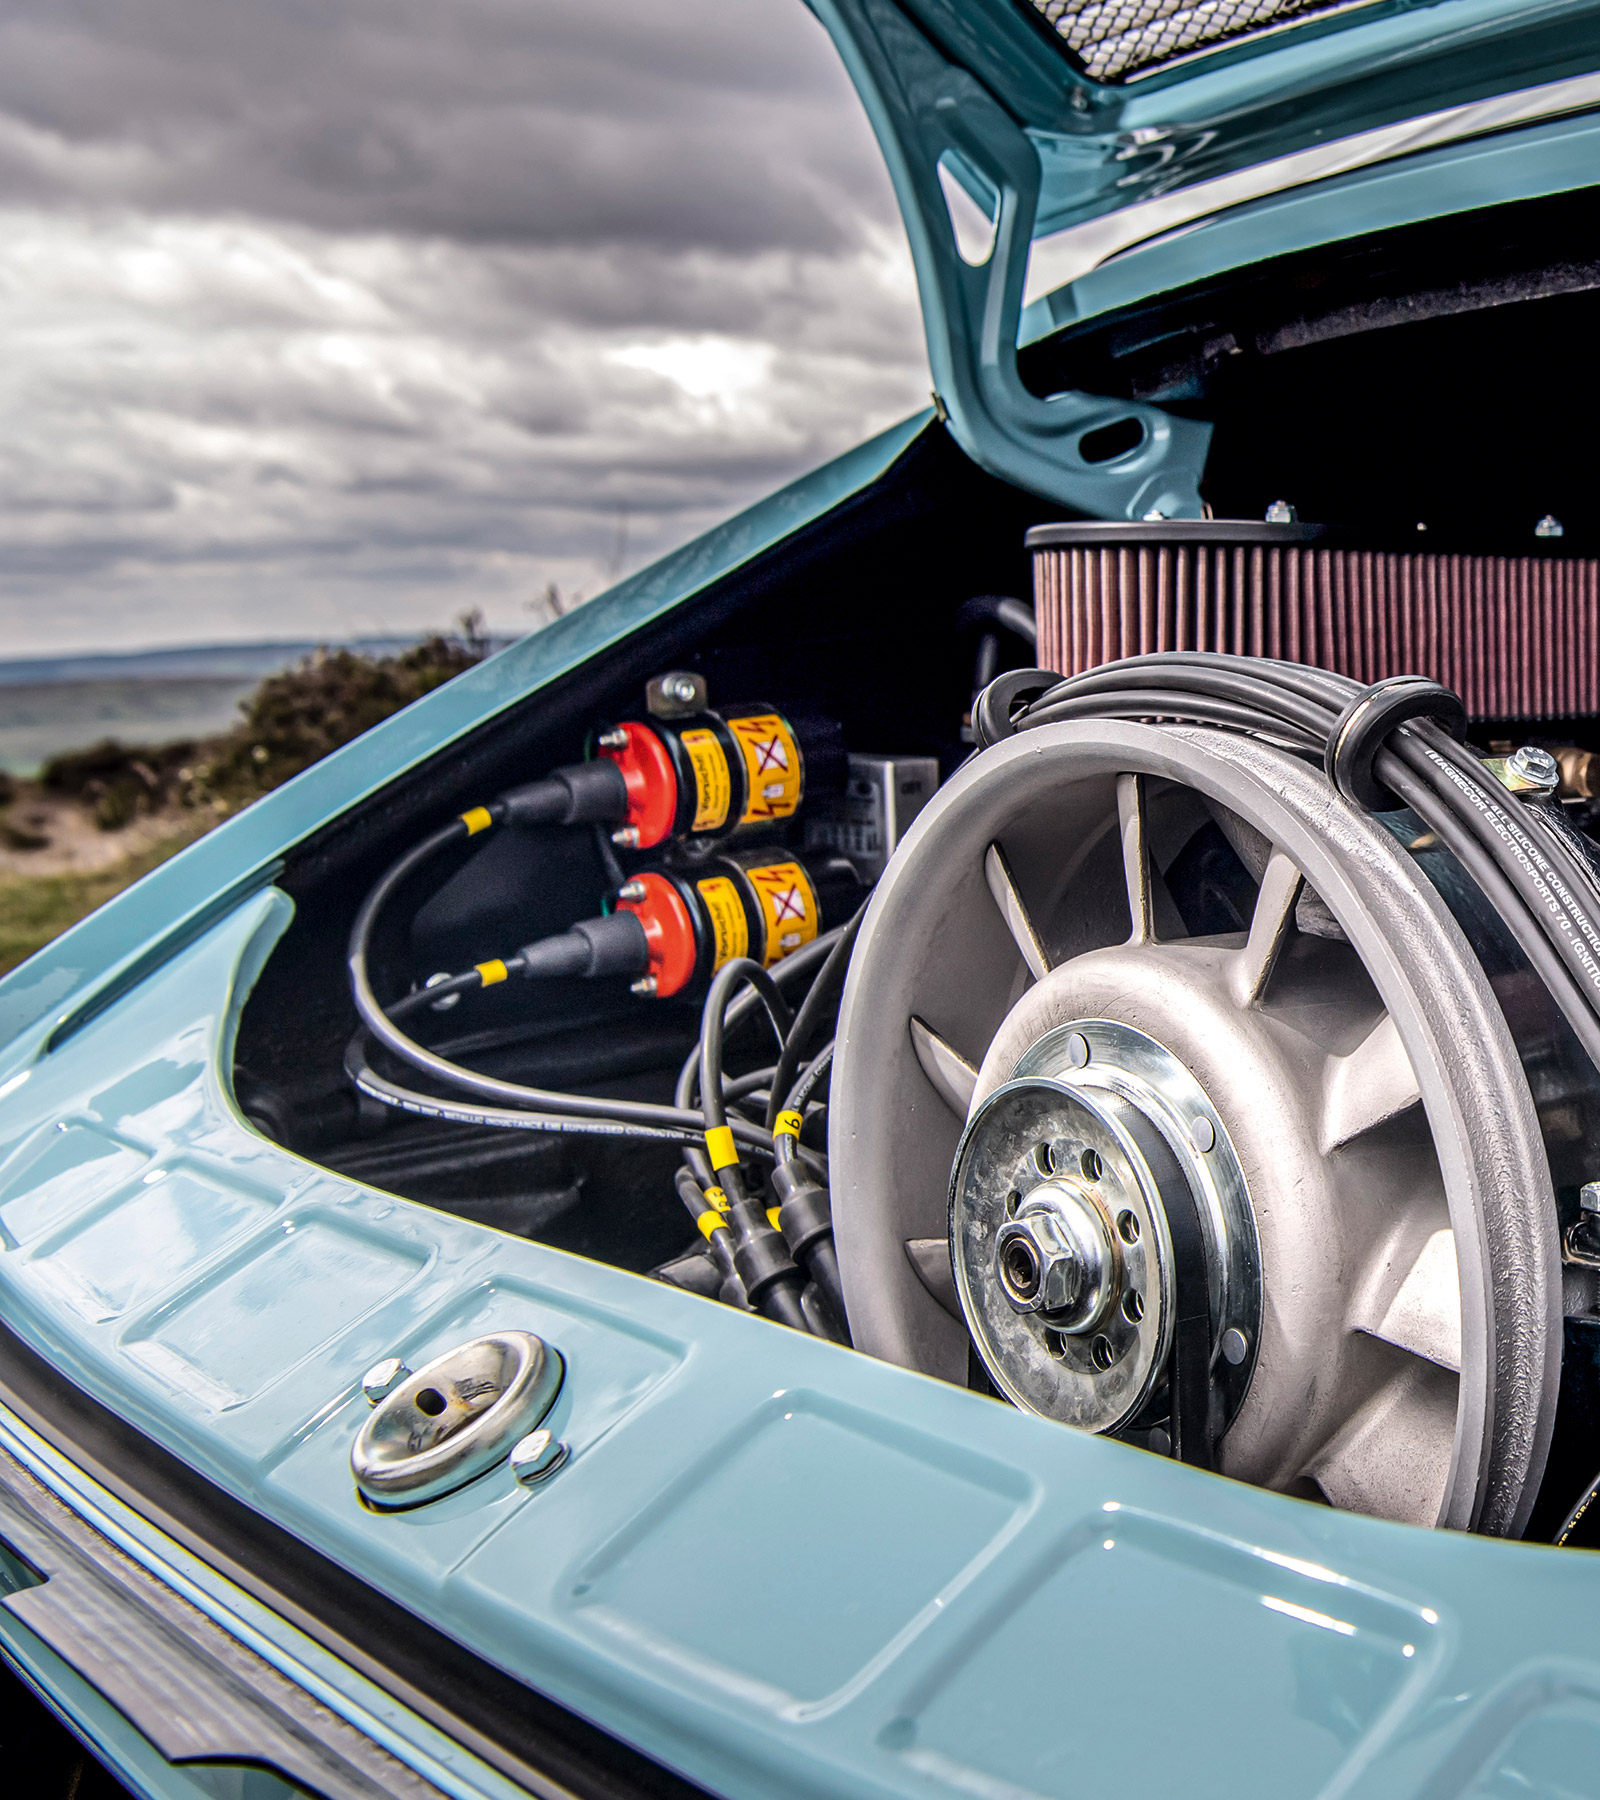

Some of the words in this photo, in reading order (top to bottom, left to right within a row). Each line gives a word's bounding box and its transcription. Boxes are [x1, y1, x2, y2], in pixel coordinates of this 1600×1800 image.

[1425, 749, 1487, 812] MAGNECOR
[1483, 810, 1562, 914] ELECTROSPORTS
[1555, 913, 1572, 932] 70
[1489, 804, 1508, 826] ALL
[1506, 821, 1550, 873] SILICONE
[485, 1116, 543, 1131] INDUCTANCE
[563, 1123, 624, 1135] SUPPRESSED
[626, 1126, 685, 1140] CONDUCTOR
